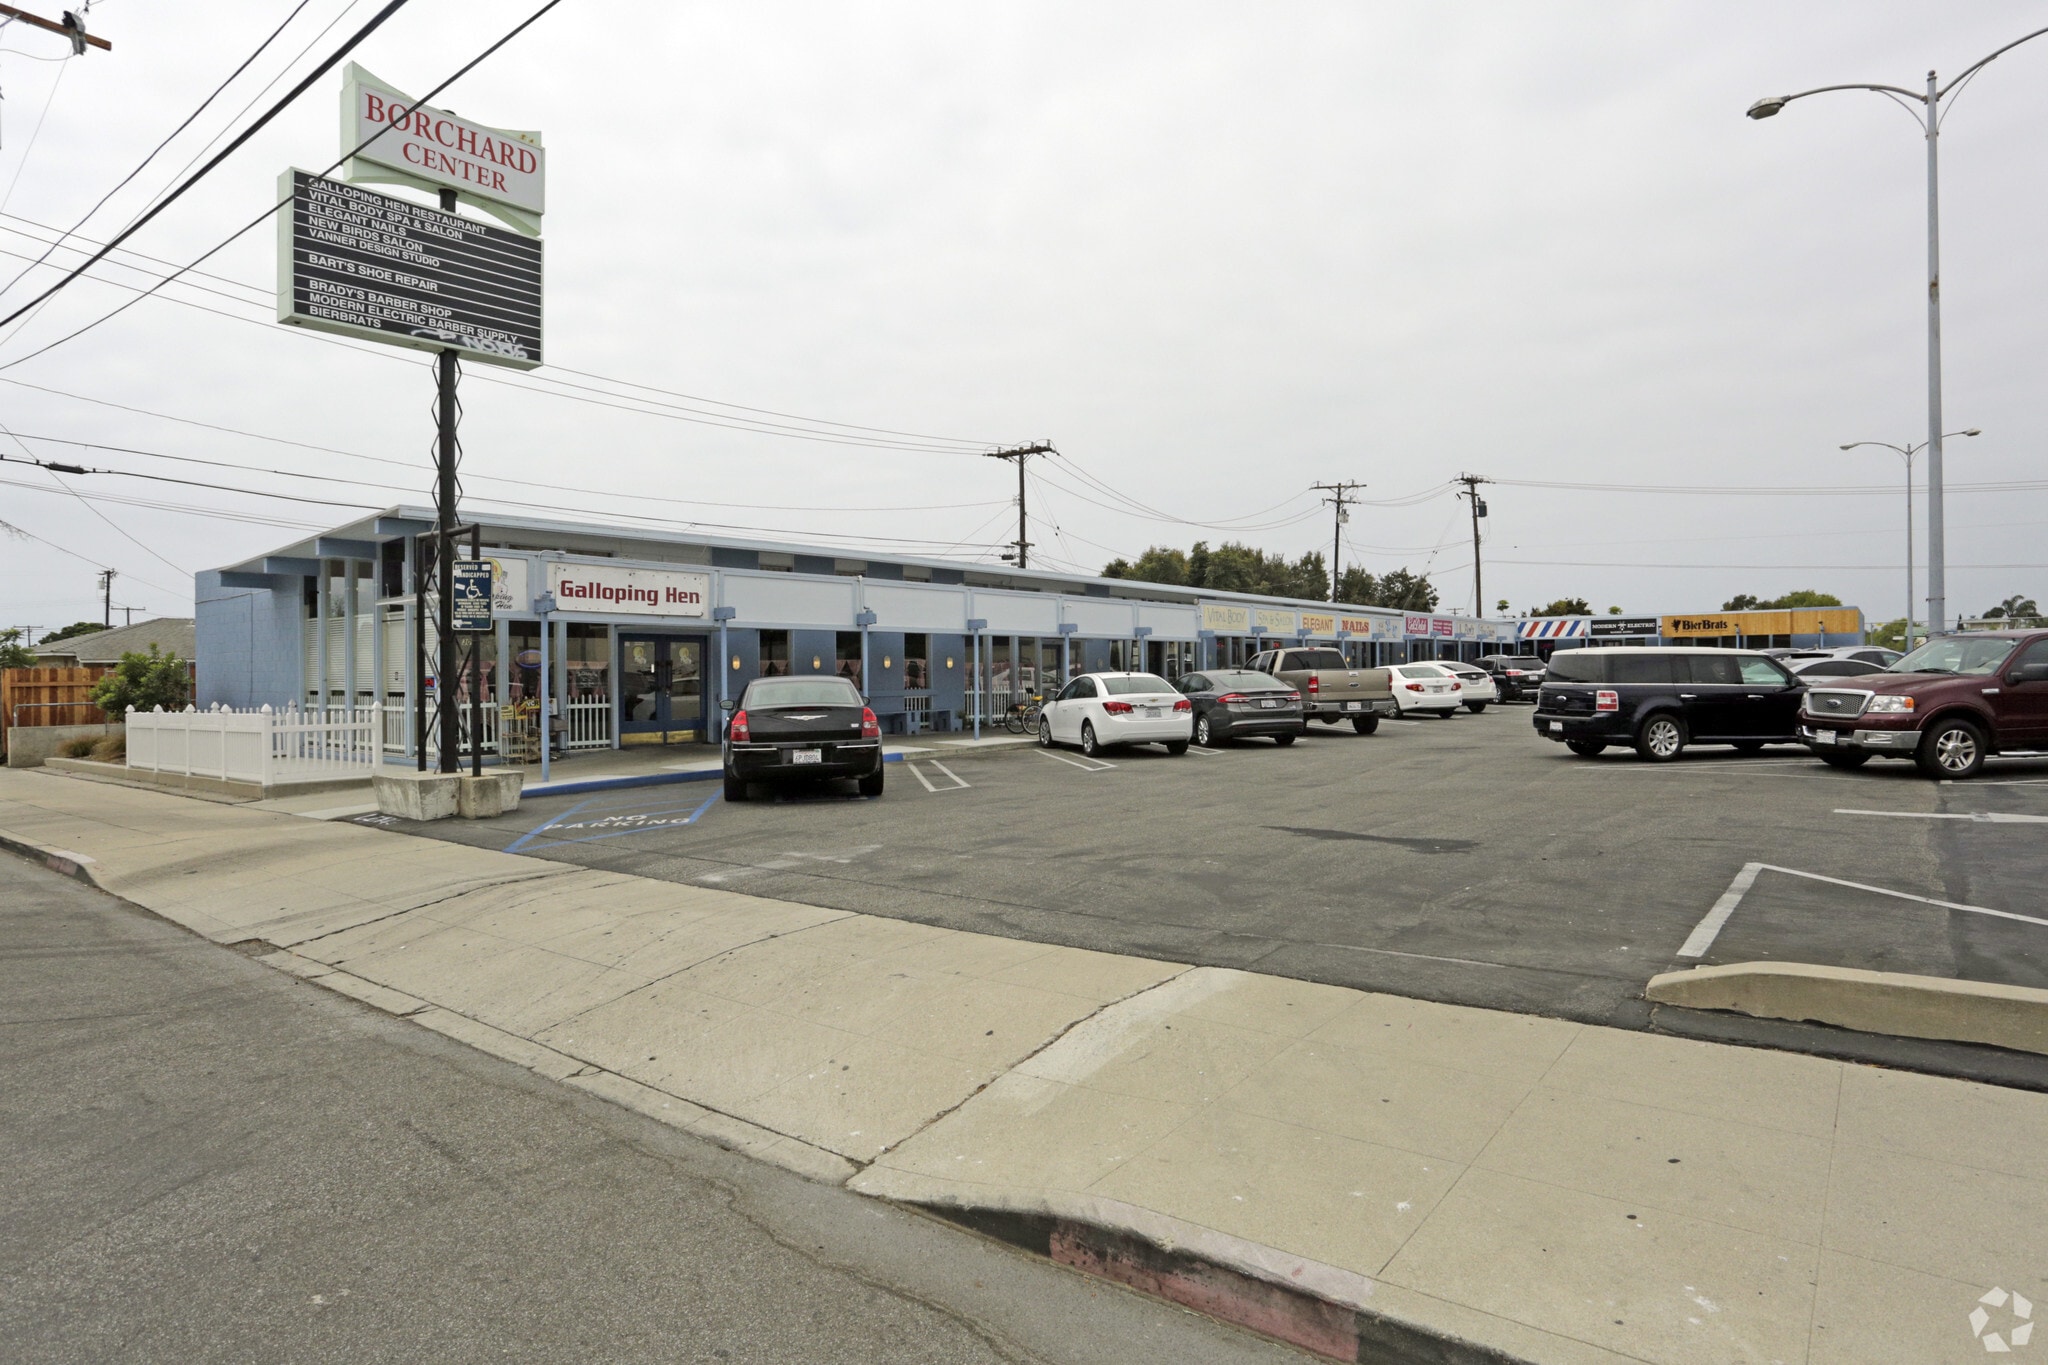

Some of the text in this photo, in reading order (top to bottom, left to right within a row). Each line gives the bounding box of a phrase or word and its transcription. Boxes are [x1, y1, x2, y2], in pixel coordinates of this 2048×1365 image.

[365, 93, 537, 174] BORCHARD
[402, 142, 508, 193] CENTER
[309, 178, 486, 235] GALLOPING HEN RESTAURANT
[309, 190, 463, 240] VITAL BODY SPA & SALON
[309, 203, 407, 236] ELEGANT NAILS
[309, 215, 423, 252] NEW BIRDS SALON
[309, 228, 440, 267] VANNER DESIGN STUDIO
[309, 254, 438, 292] BART'S SHOE REPAIR
[309, 280, 452, 318] BRADY'S BARBER SHOP
[309, 305, 382, 328] BIERBRATS
[309, 292, 365, 312] MODERN
[368, 305, 426, 325] ELECTRIC
[428, 318, 475, 335] BARBER
[477, 328, 518, 344] SUPPLY
[560, 580, 700, 606] Galloping Hen
[1302, 617, 1333, 631] ELEGANT
[1341, 620, 1369, 633] NAILS
[1682, 619, 1728, 630] BierBrats
[543, 817, 691, 830] PARKING
[603, 814, 647, 822] NO
